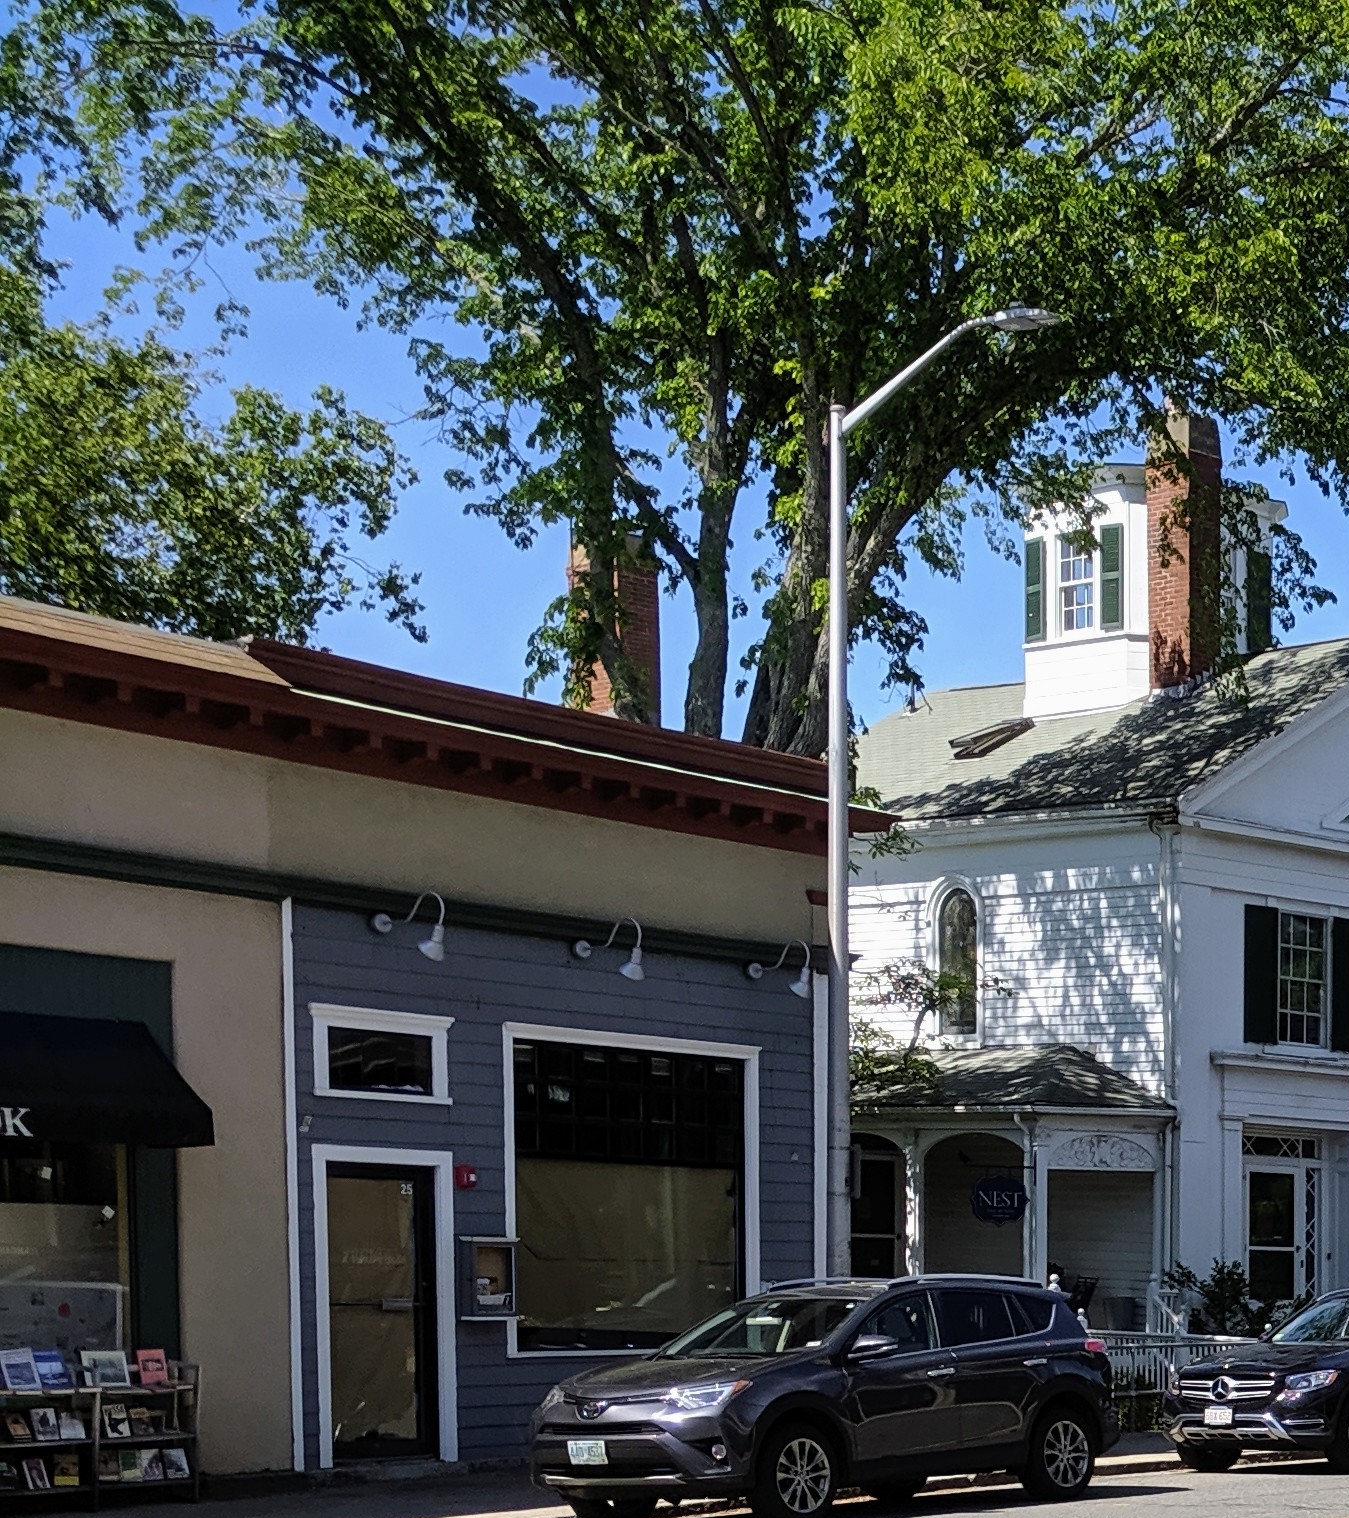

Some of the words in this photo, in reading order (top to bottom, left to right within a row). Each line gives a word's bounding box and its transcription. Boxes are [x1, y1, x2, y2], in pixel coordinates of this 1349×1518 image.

[0, 1106, 34, 1137] K
[400, 1184, 413, 1195] 25
[978, 1190, 1023, 1208] NEST
